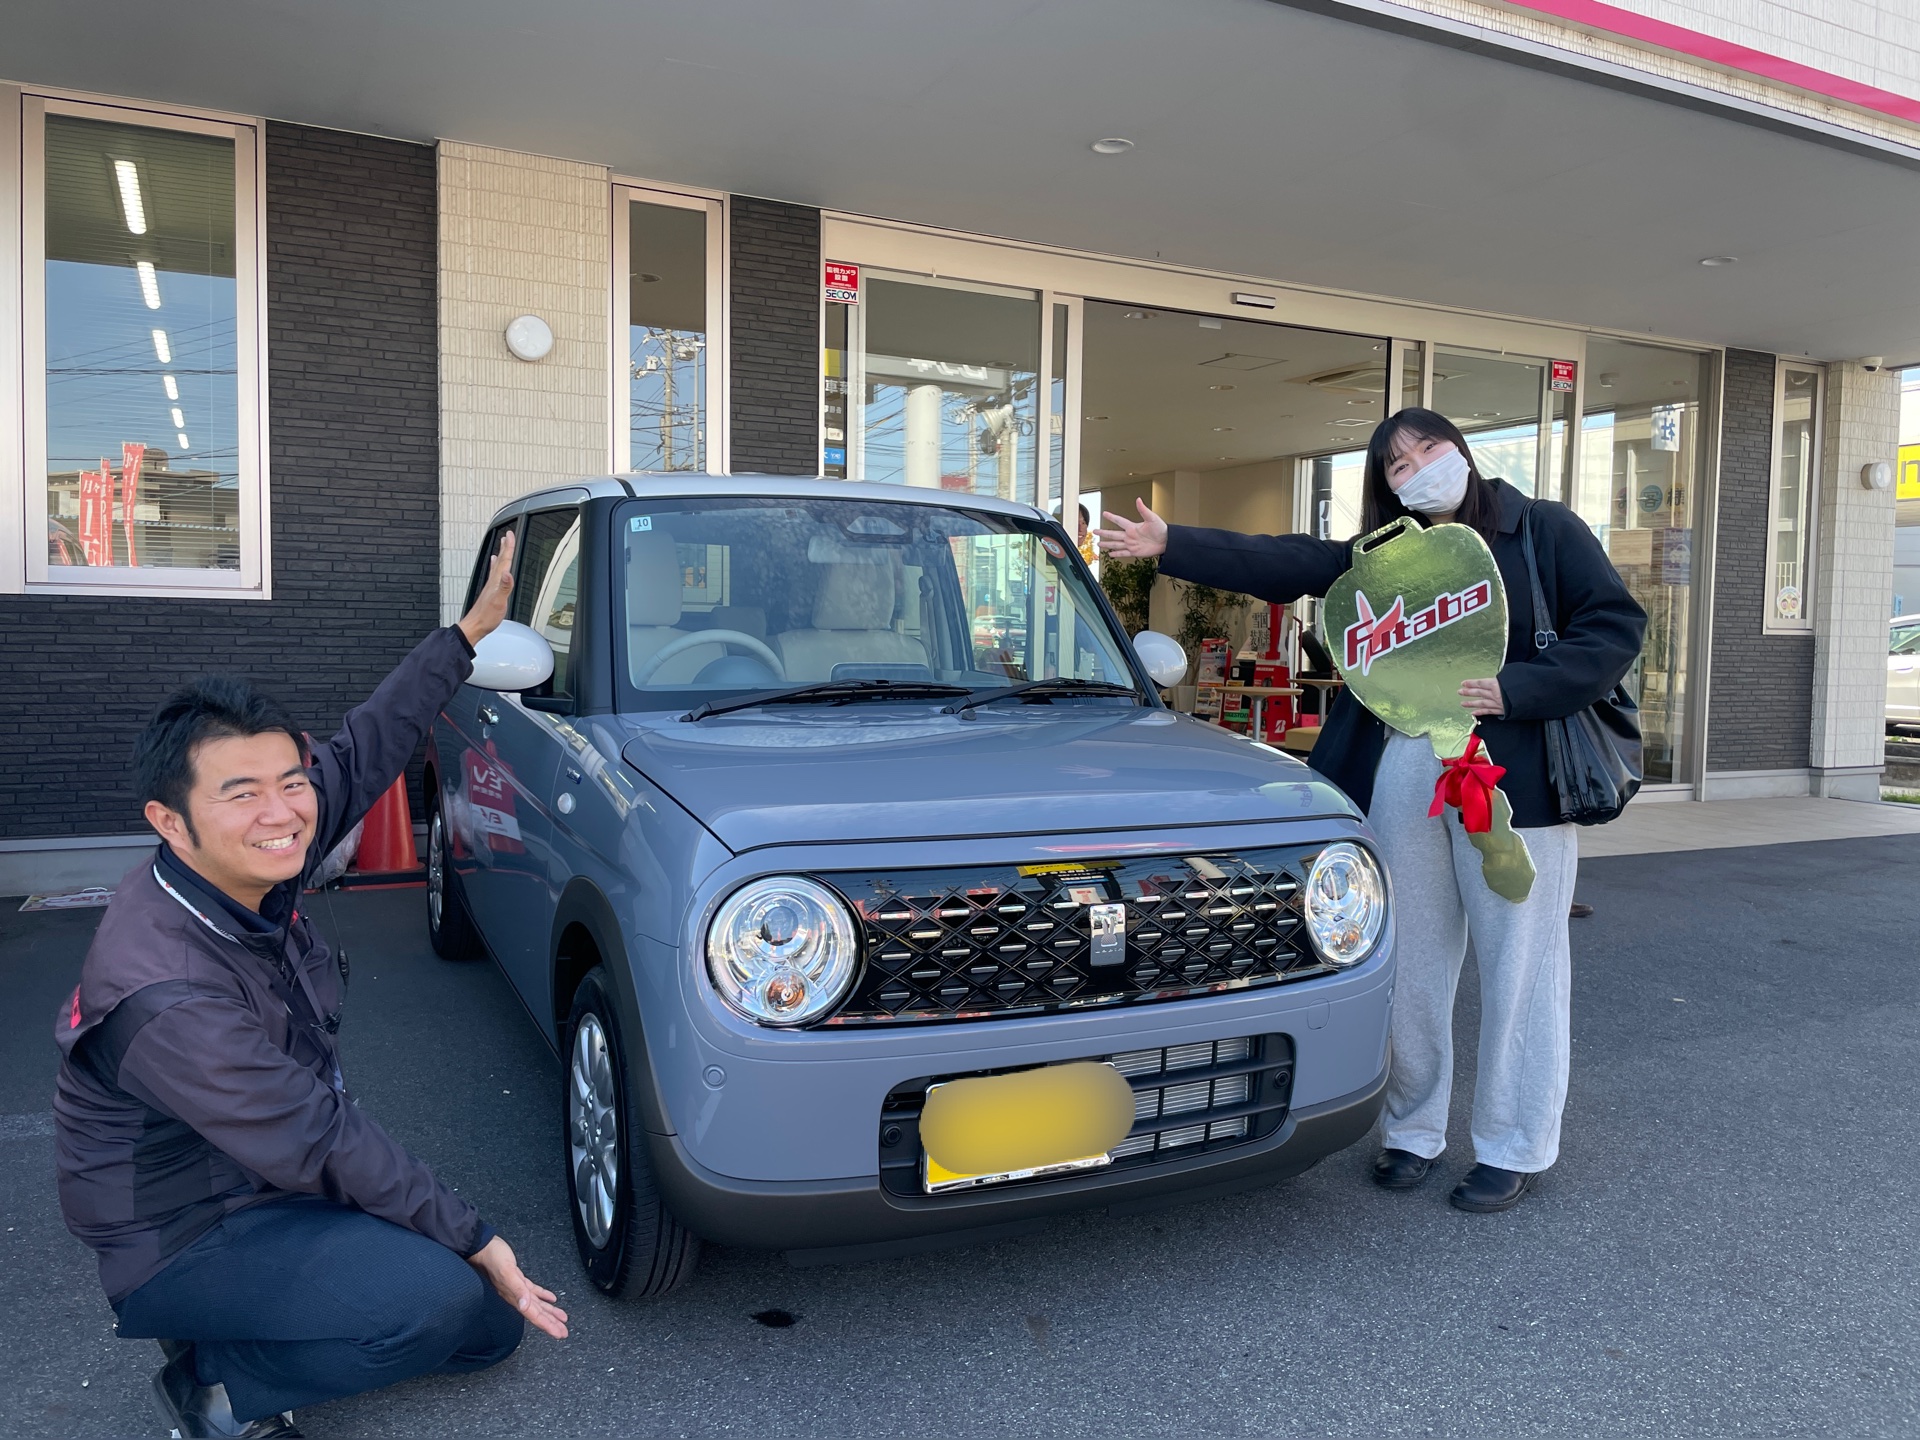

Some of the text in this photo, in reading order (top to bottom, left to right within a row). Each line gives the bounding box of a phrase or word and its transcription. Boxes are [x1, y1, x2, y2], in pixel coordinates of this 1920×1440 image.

[826, 289, 857, 301] SECOM
[637, 518, 649, 527] 10
[1347, 583, 1488, 670] Futaba
